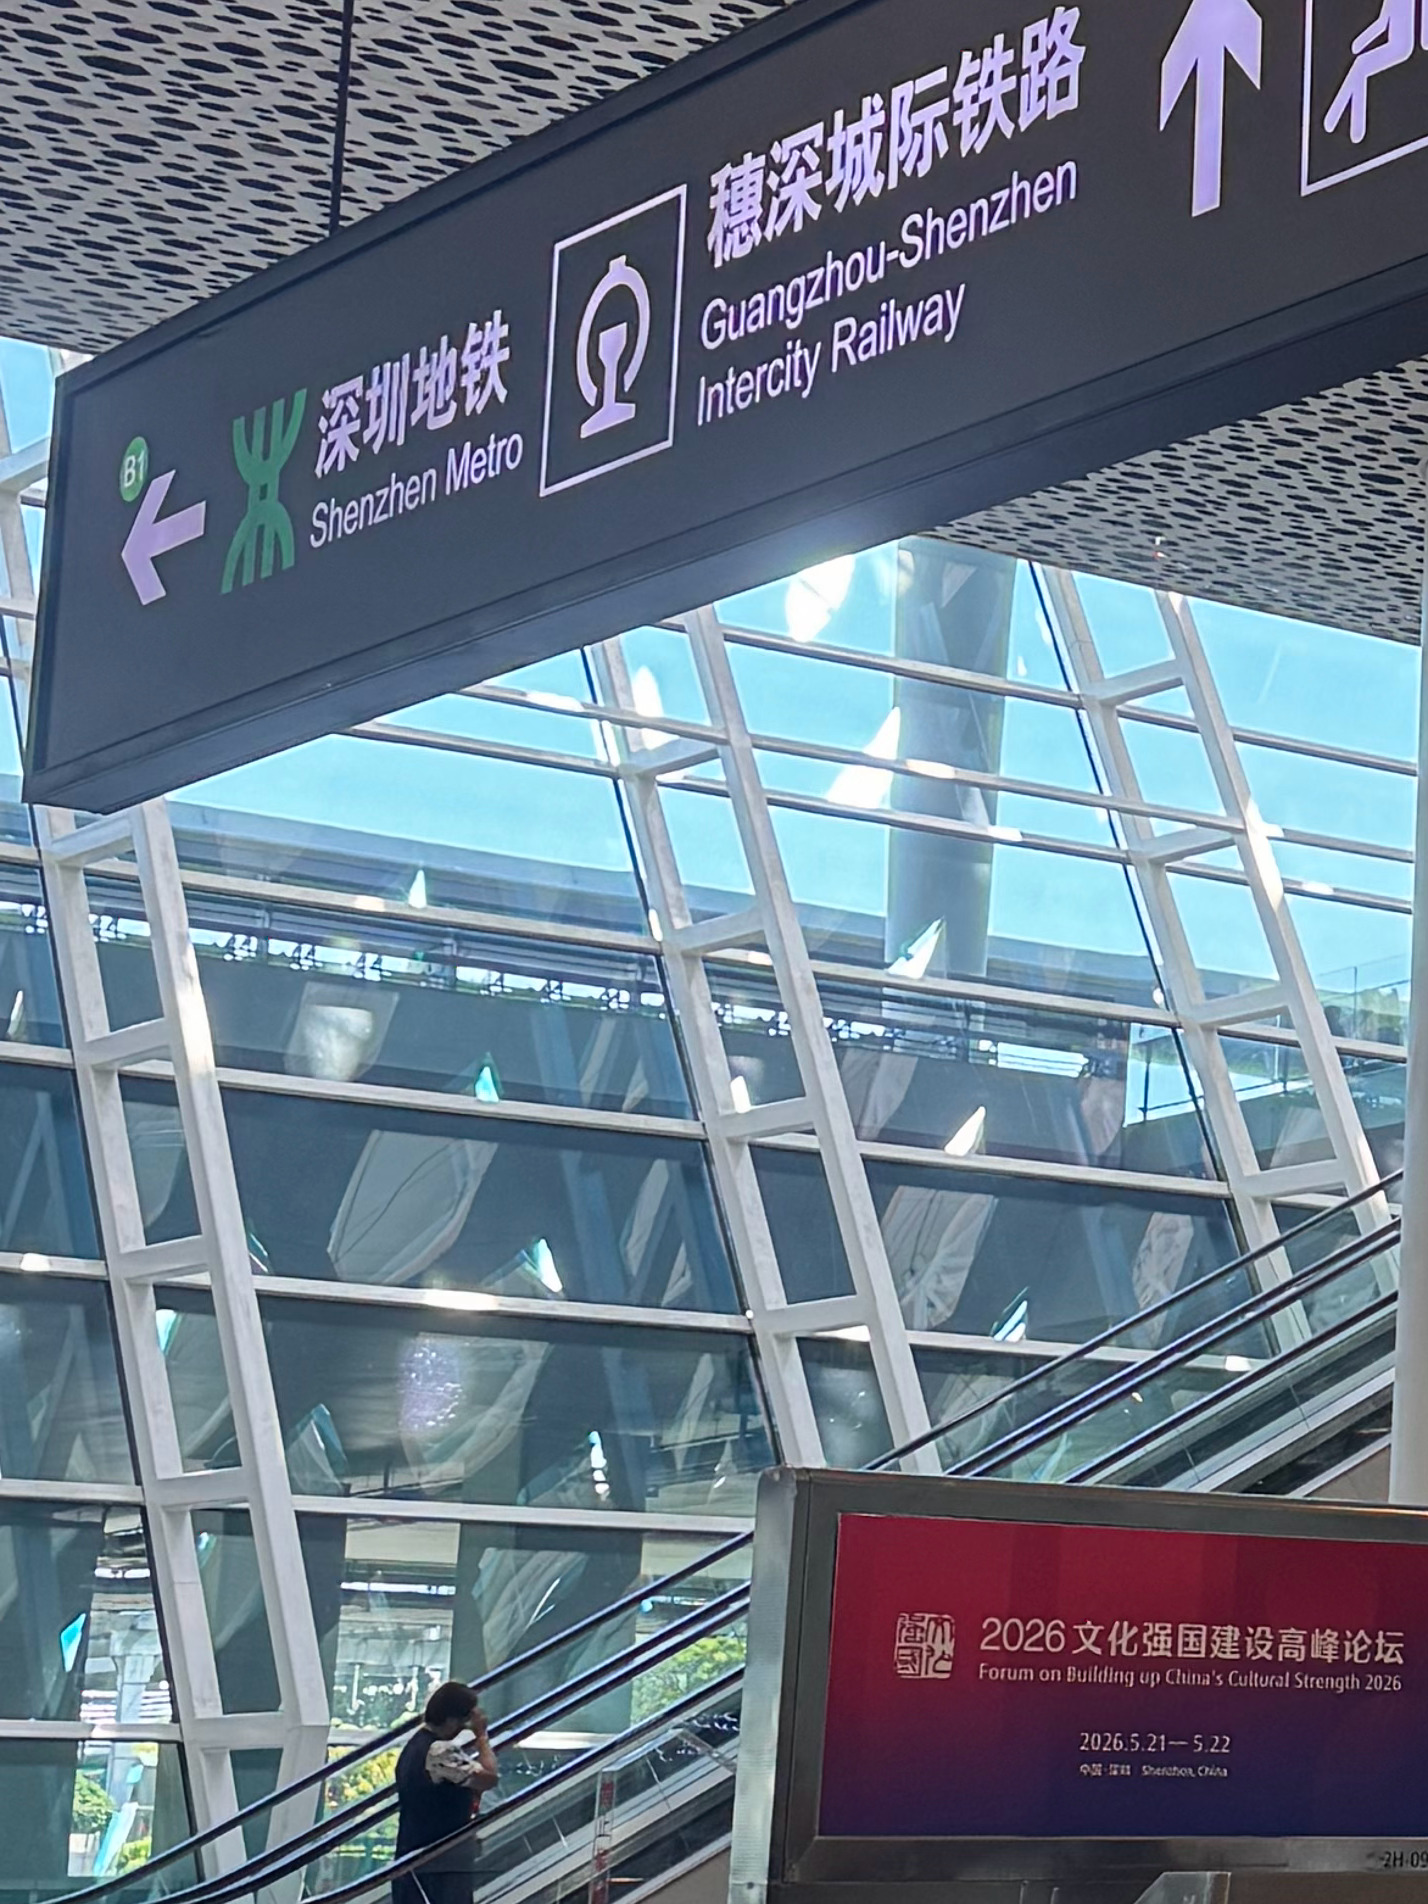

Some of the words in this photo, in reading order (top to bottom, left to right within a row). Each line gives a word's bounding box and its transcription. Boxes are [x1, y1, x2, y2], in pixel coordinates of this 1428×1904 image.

[706, 5, 1087, 268] 穗深城际铁路
[699, 159, 1078, 351] Guangzhou-Shenzhen
[314, 309, 511, 480] 深圳地铁
[697, 339, 822, 426] Intercity
[830, 282, 967, 373] Railway
[122, 447, 148, 489] B1
[309, 468, 437, 549] Shenzhen
[444, 431, 524, 496] Metro
[978, 1662, 1034, 1681] Forum
[1038, 1667, 1062, 1682] on
[1066, 1664, 1135, 1688] Building
[1139, 1669, 1161, 1688] up
[1165, 1668, 1224, 1687] China's
[1227, 1669, 1290, 1689] Cultural
[1293, 1671, 1361, 1694] Strength
[1364, 1673, 1402, 1692] 2026
[979, 1616, 1066, 1652] 2026
[1071, 1619, 1405, 1665] 文化强国建设高峰论坛
